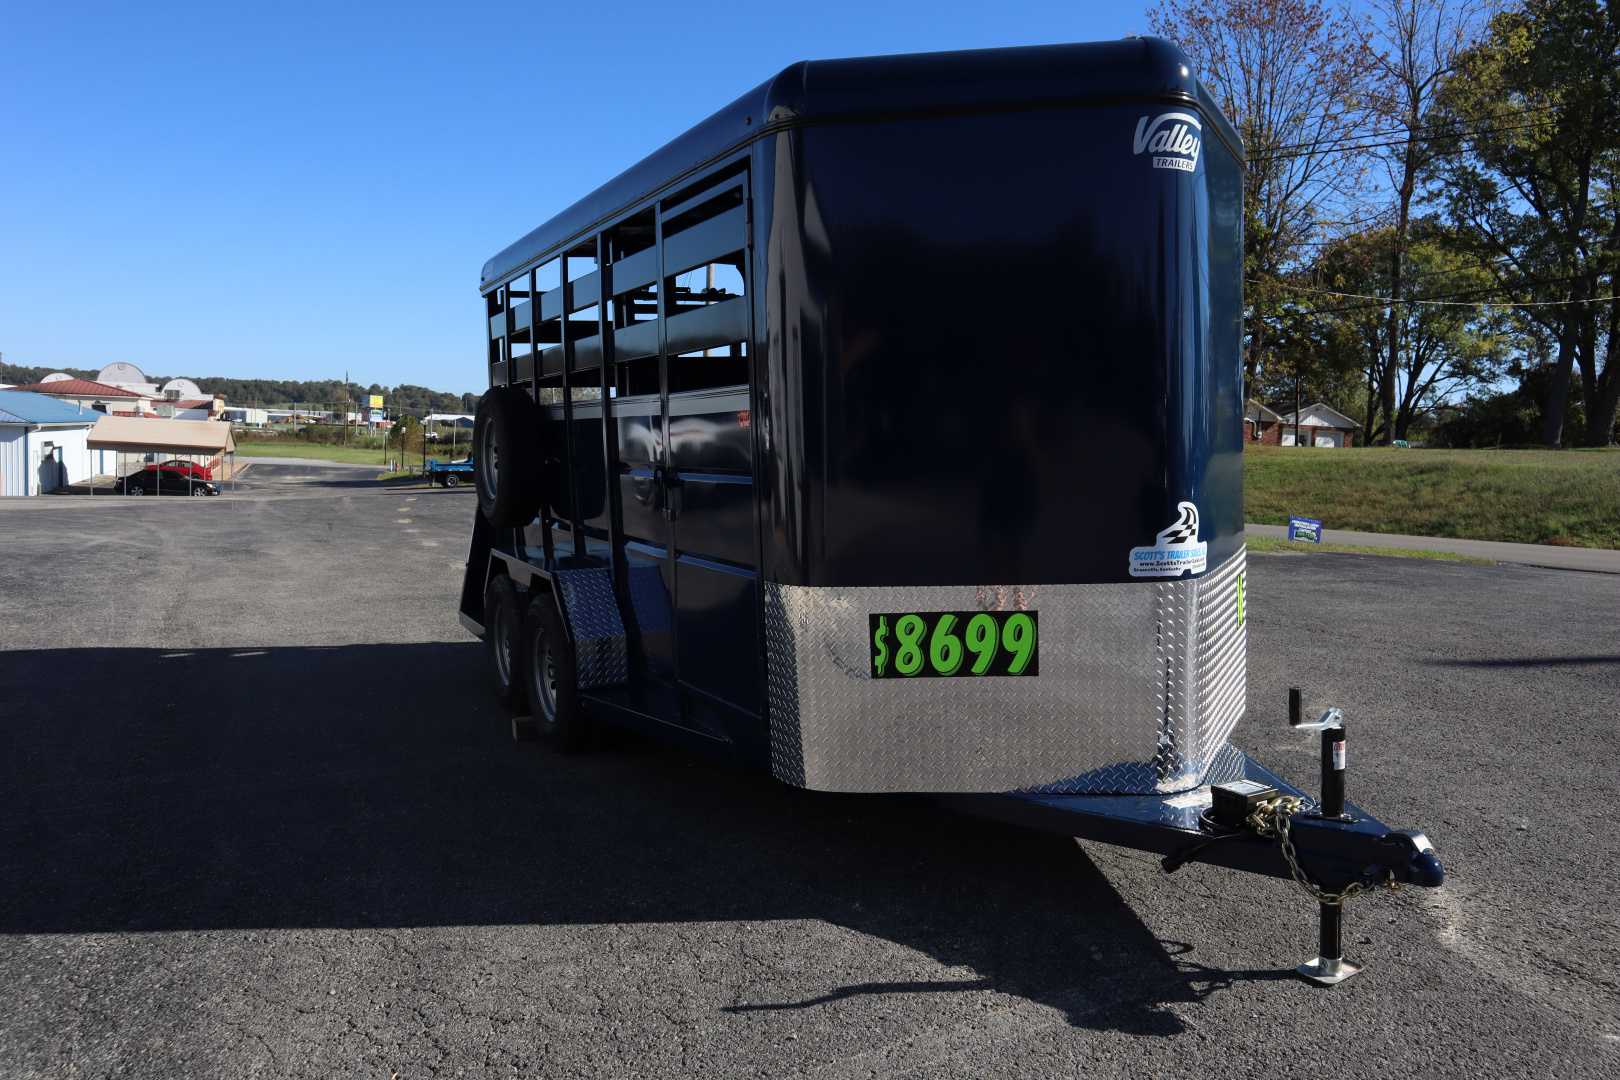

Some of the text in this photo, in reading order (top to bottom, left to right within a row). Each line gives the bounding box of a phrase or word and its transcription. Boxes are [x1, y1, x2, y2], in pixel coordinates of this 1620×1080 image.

[1133, 112, 1202, 165] Valley
[1156, 158, 1193, 170] TRAILERS
[1134, 551, 1165, 560] SCOTT'S
[1166, 549, 1190, 560] TRAILER
[874, 612, 1037, 677] $8699
